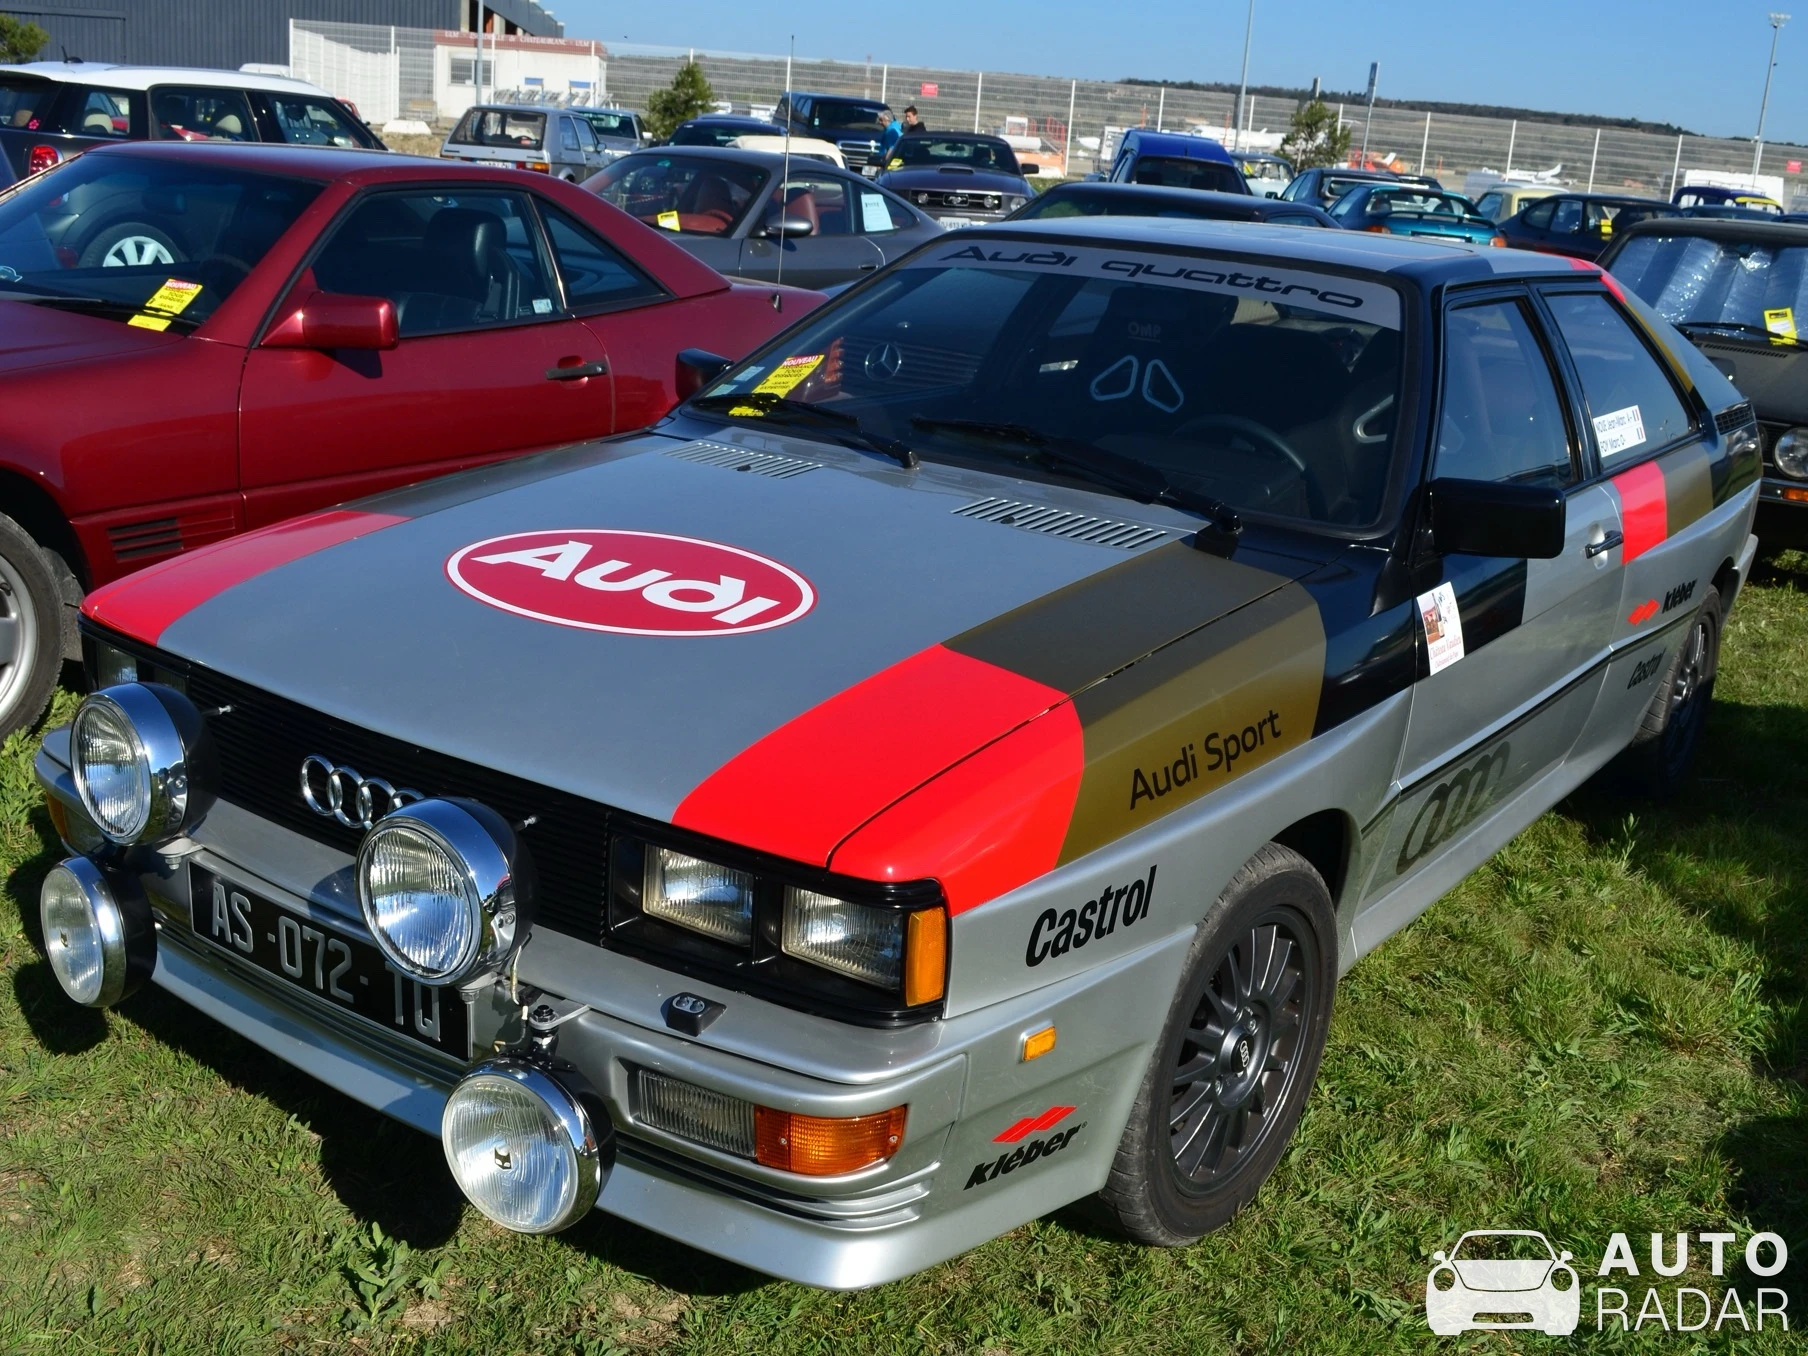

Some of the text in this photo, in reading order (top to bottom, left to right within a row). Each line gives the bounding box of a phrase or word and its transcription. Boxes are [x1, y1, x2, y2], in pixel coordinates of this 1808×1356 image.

[937, 244, 1364, 309] Audi quattro
[782, 355, 819, 367] NOUVEAU
[470, 540, 781, 625] Audi
[1626, 647, 1667, 690] Castrol
[1129, 709, 1282, 811] Audi Sport
[1024, 864, 1158, 968] Castrol
